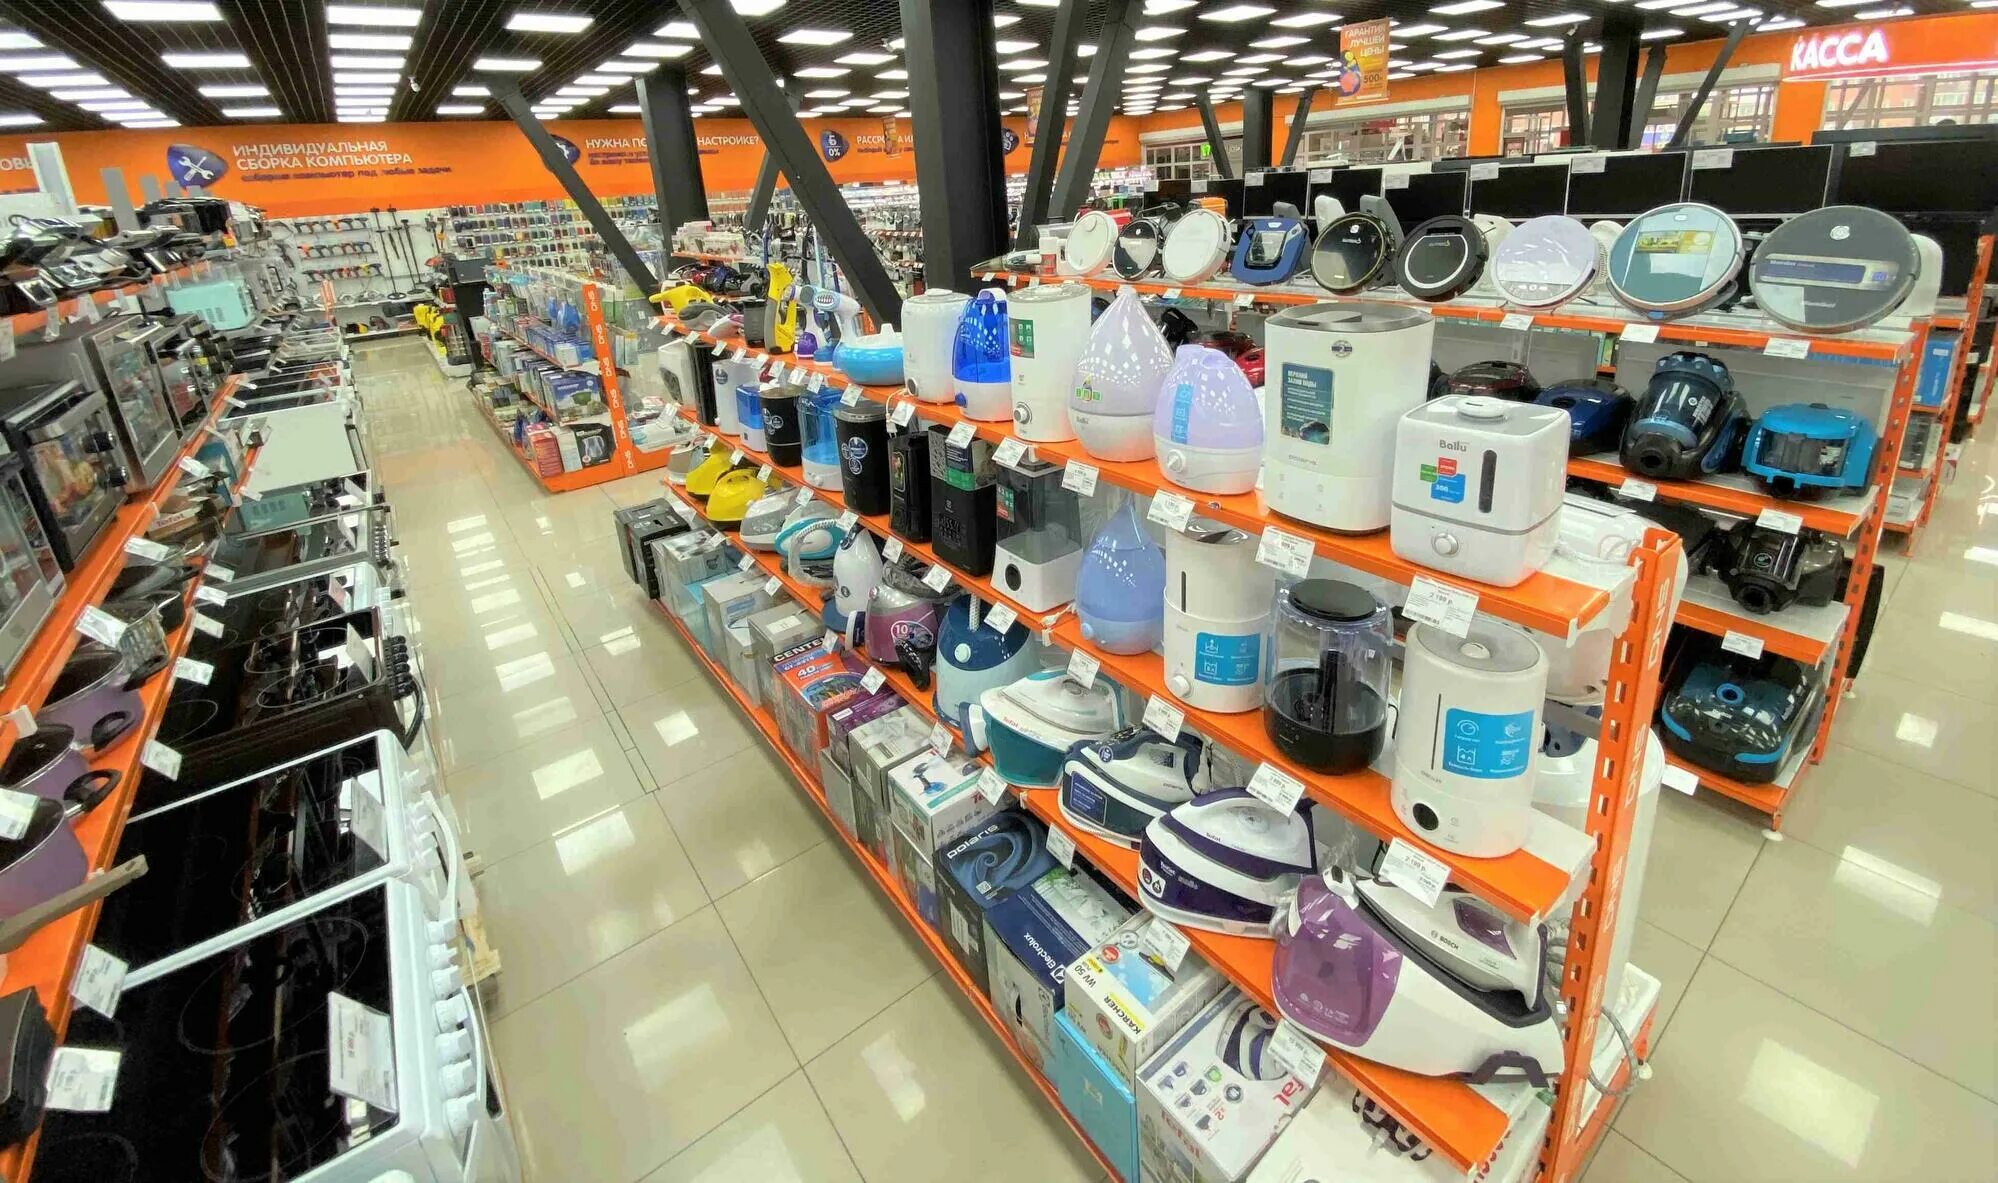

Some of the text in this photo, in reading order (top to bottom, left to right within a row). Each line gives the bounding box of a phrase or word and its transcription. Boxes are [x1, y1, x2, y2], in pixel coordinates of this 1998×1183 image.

[1344, 25, 1386, 39] ГАРАНТИЯ
[1350, 34, 1385, 49] ЛУЧШЕЙ
[1360, 46, 1385, 57] ЦЕНЫ
[1790, 29, 1889, 71] КАССА
[1363, 73, 1380, 84] 500
[232, 140, 388, 158] ИНДИВИДУАЛЬНАЯ
[585, 138, 630, 149] НУЖНА
[828, 148, 841, 157] 0%
[236, 153, 413, 171] СБОРКА КОМПЬЮТЕРА
[1440, 439, 1467, 452] Ballu
[894, 624, 909, 635] 10
[1647, 577, 1670, 671] DNS
[774, 637, 825, 662] CENTE
[798, 665, 816, 677] 40
[1624, 723, 1647, 809] DNS
[947, 824, 999, 859] polaris
[1023, 931, 1057, 969] Electrolux
[1440, 935, 1459, 950] BOSCH
